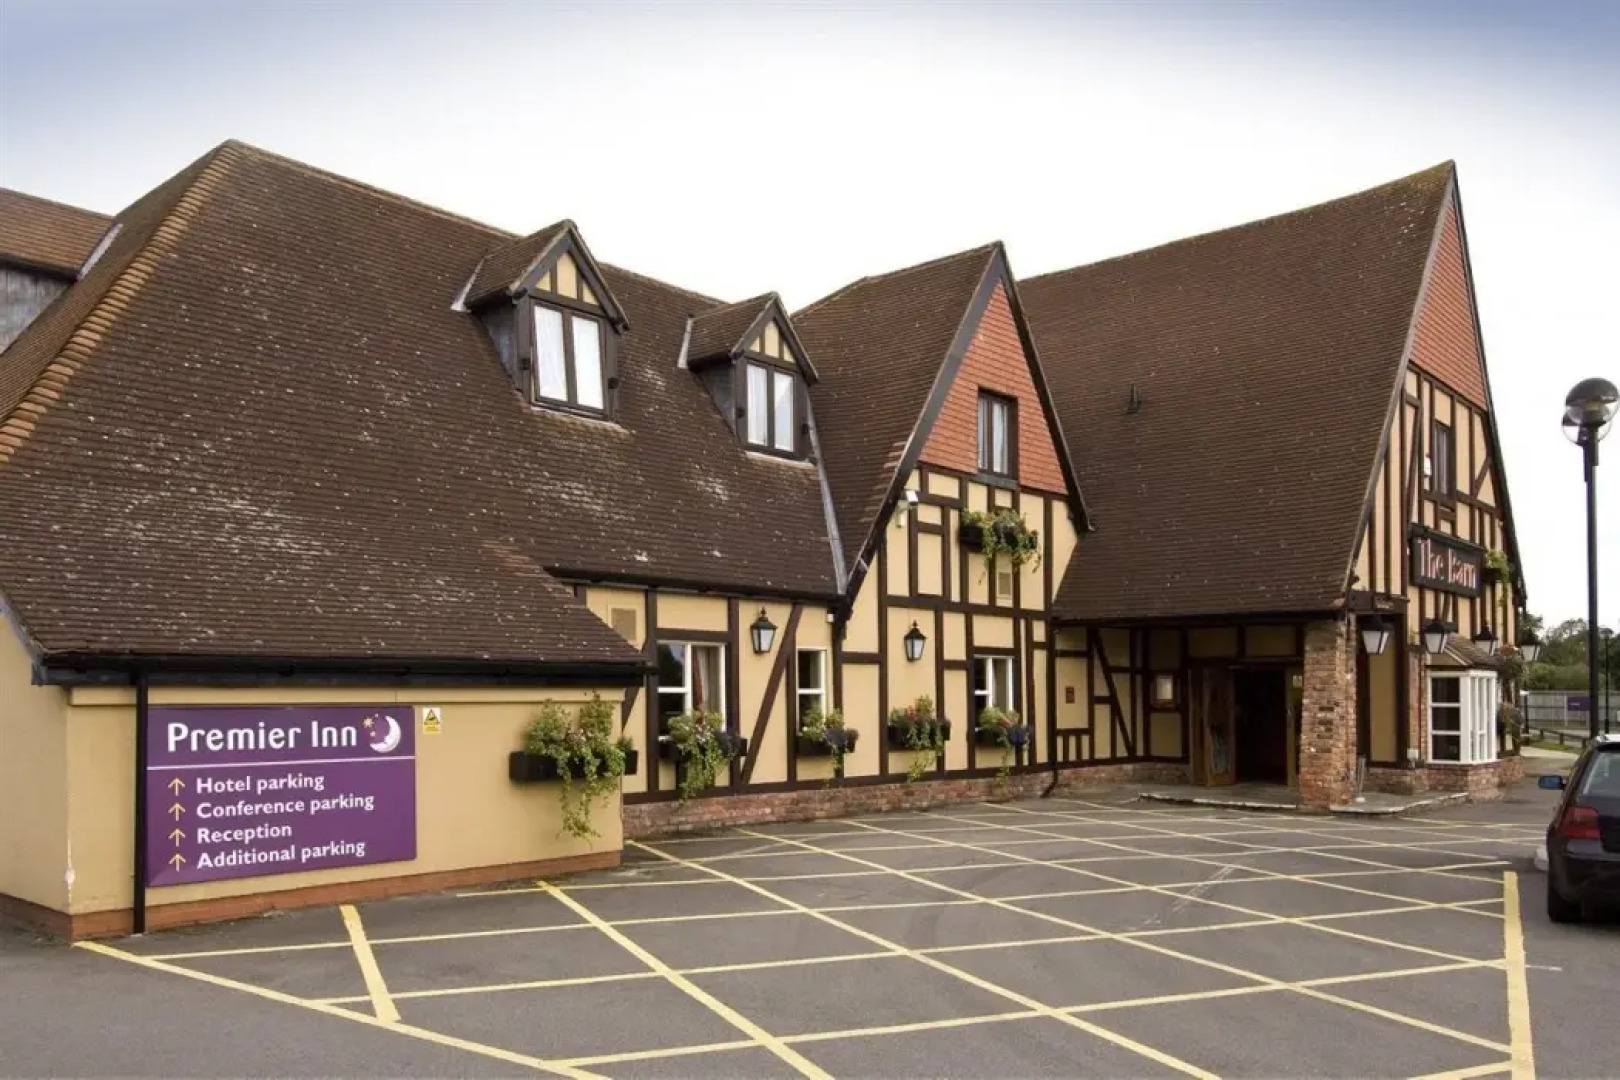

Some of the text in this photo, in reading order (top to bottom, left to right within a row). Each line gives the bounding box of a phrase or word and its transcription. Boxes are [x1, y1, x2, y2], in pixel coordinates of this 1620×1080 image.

[167, 721, 357, 752] Premier Inn
[196, 773, 325, 795] Hotel parking
[196, 793, 375, 819] Conference parking
[197, 823, 293, 845] Reception
[197, 840, 366, 870] Additional parking
